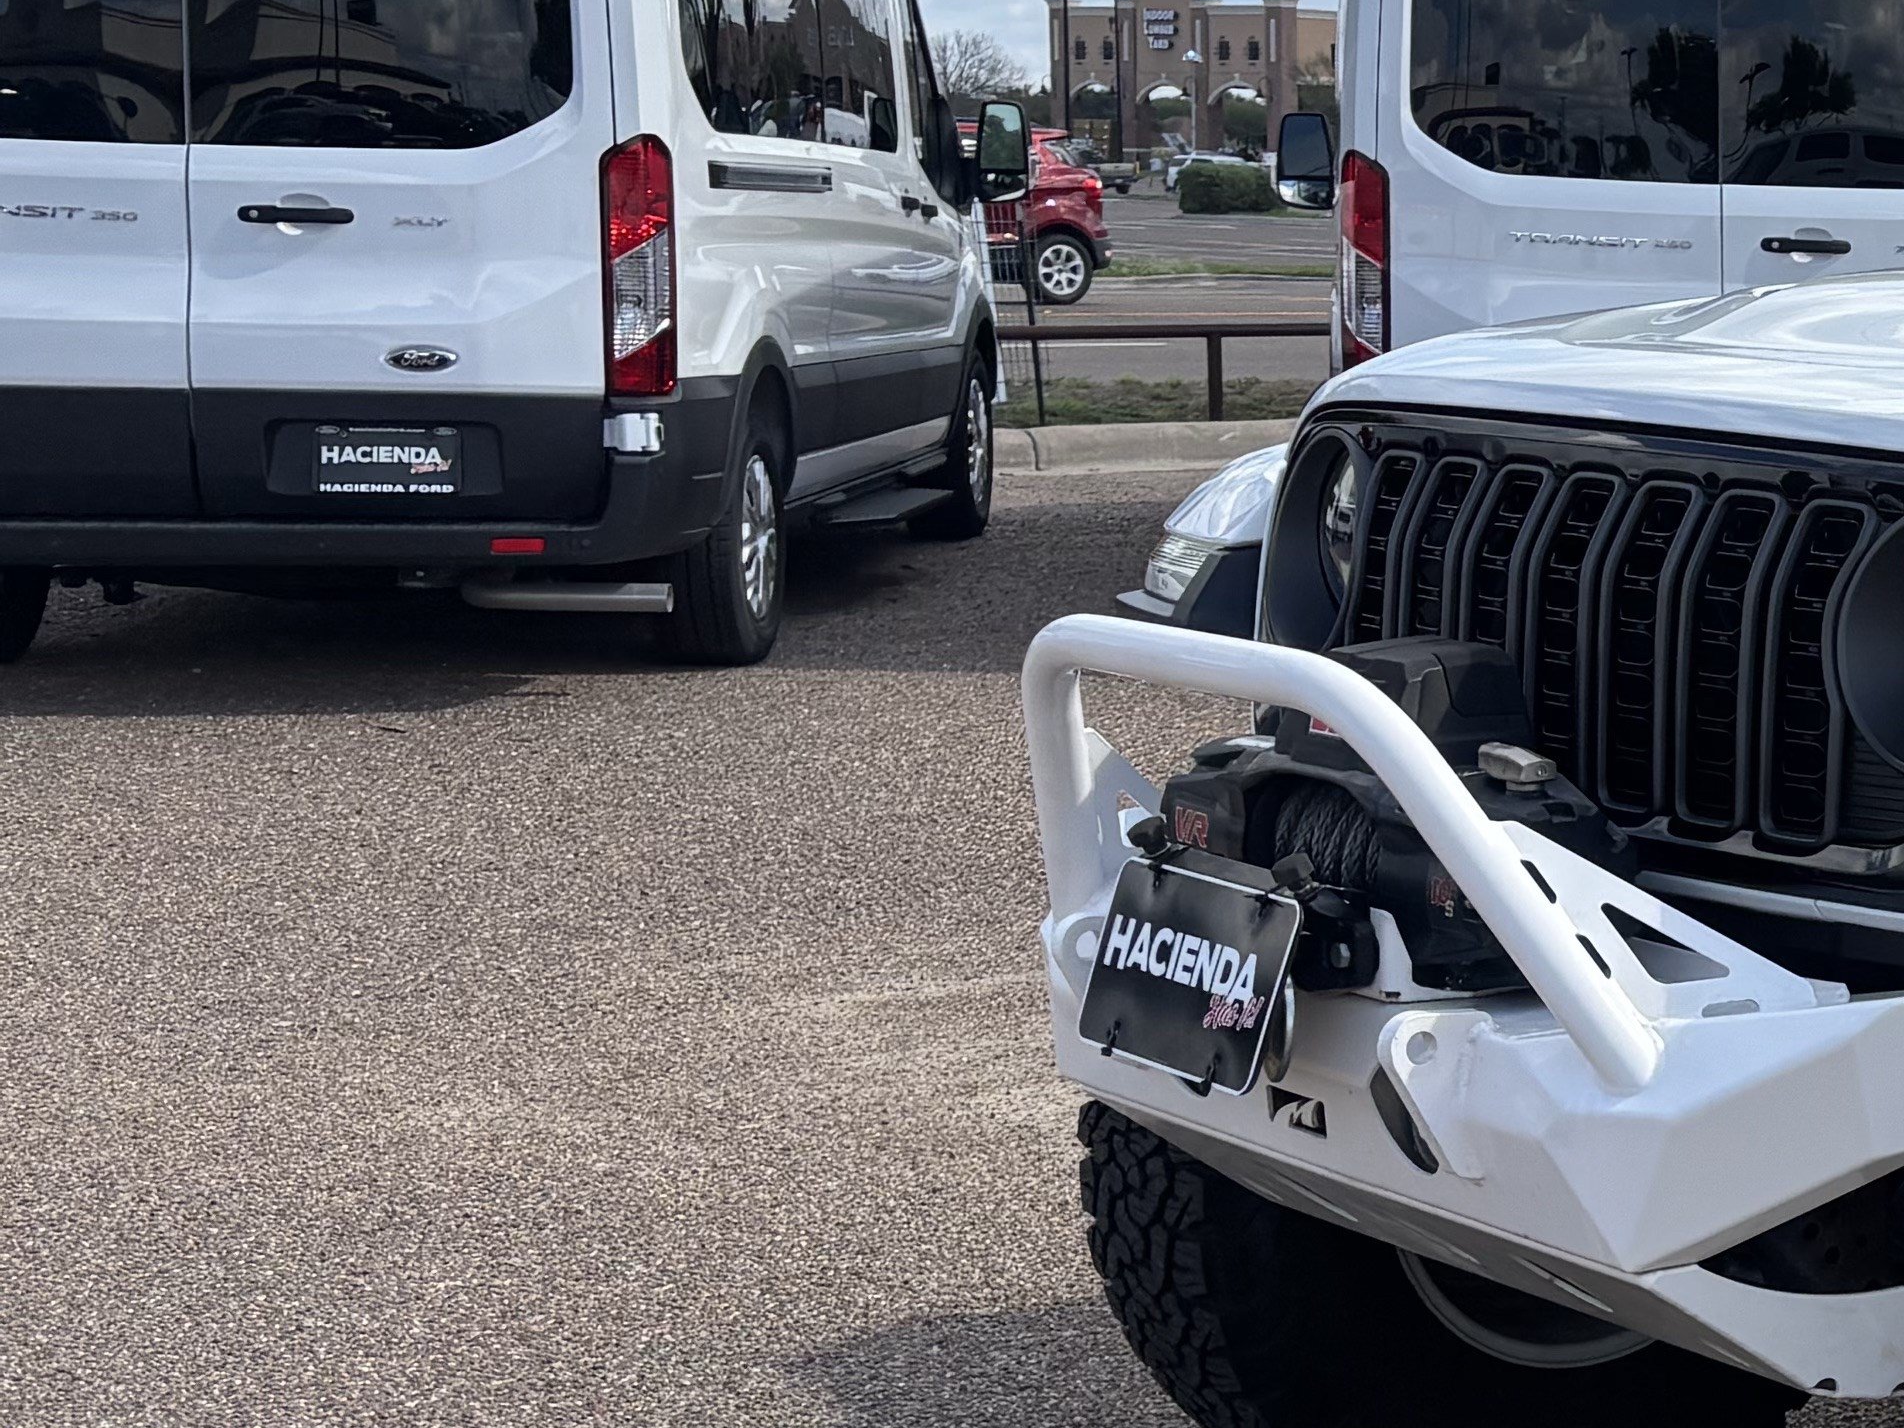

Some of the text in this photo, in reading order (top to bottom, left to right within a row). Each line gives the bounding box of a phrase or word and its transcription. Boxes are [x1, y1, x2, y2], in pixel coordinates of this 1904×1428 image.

[320, 445, 442, 464] HACIENDA
[319, 482, 454, 493] HACIENDA FORD
[1103, 913, 1258, 1005] HACIENDA
